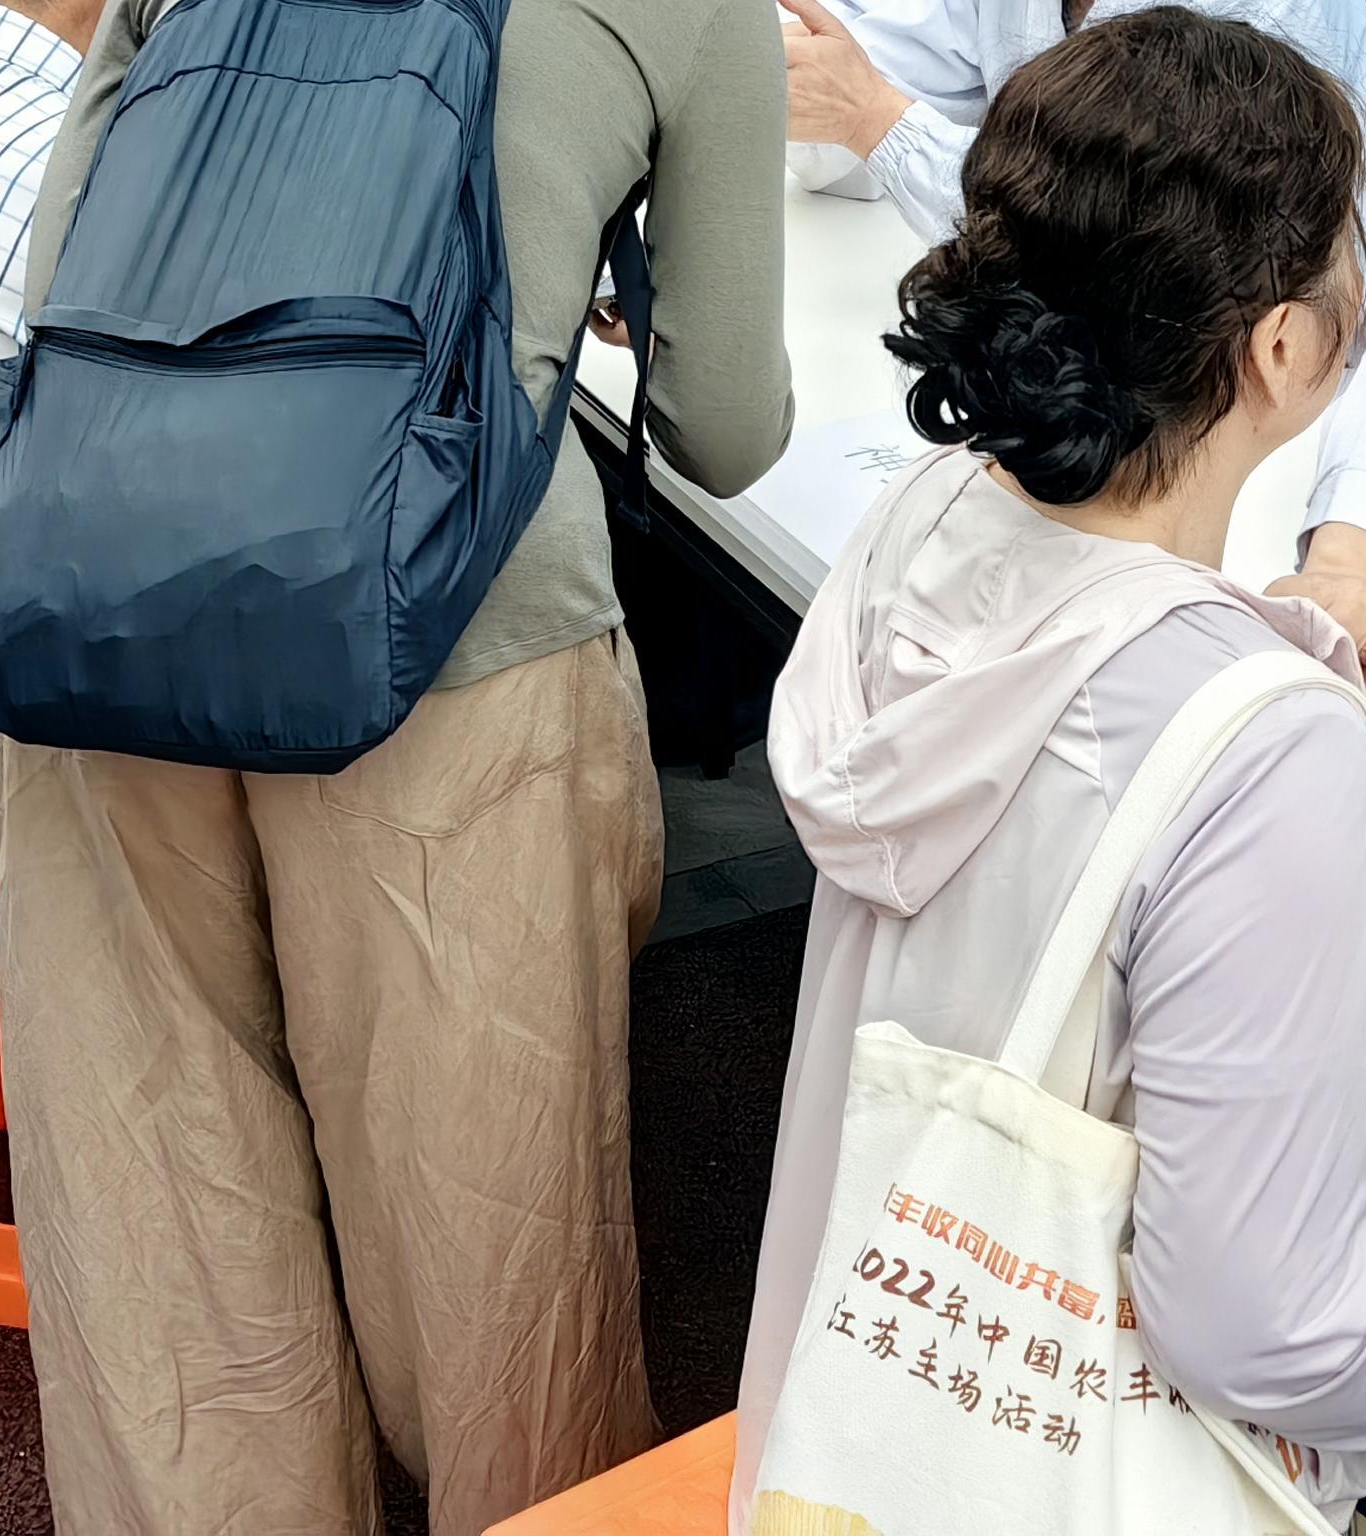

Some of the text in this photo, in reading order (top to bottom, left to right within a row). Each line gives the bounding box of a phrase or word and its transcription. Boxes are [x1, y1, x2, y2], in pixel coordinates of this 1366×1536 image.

[826, 1292, 1082, 1457] 江苏主场活动
